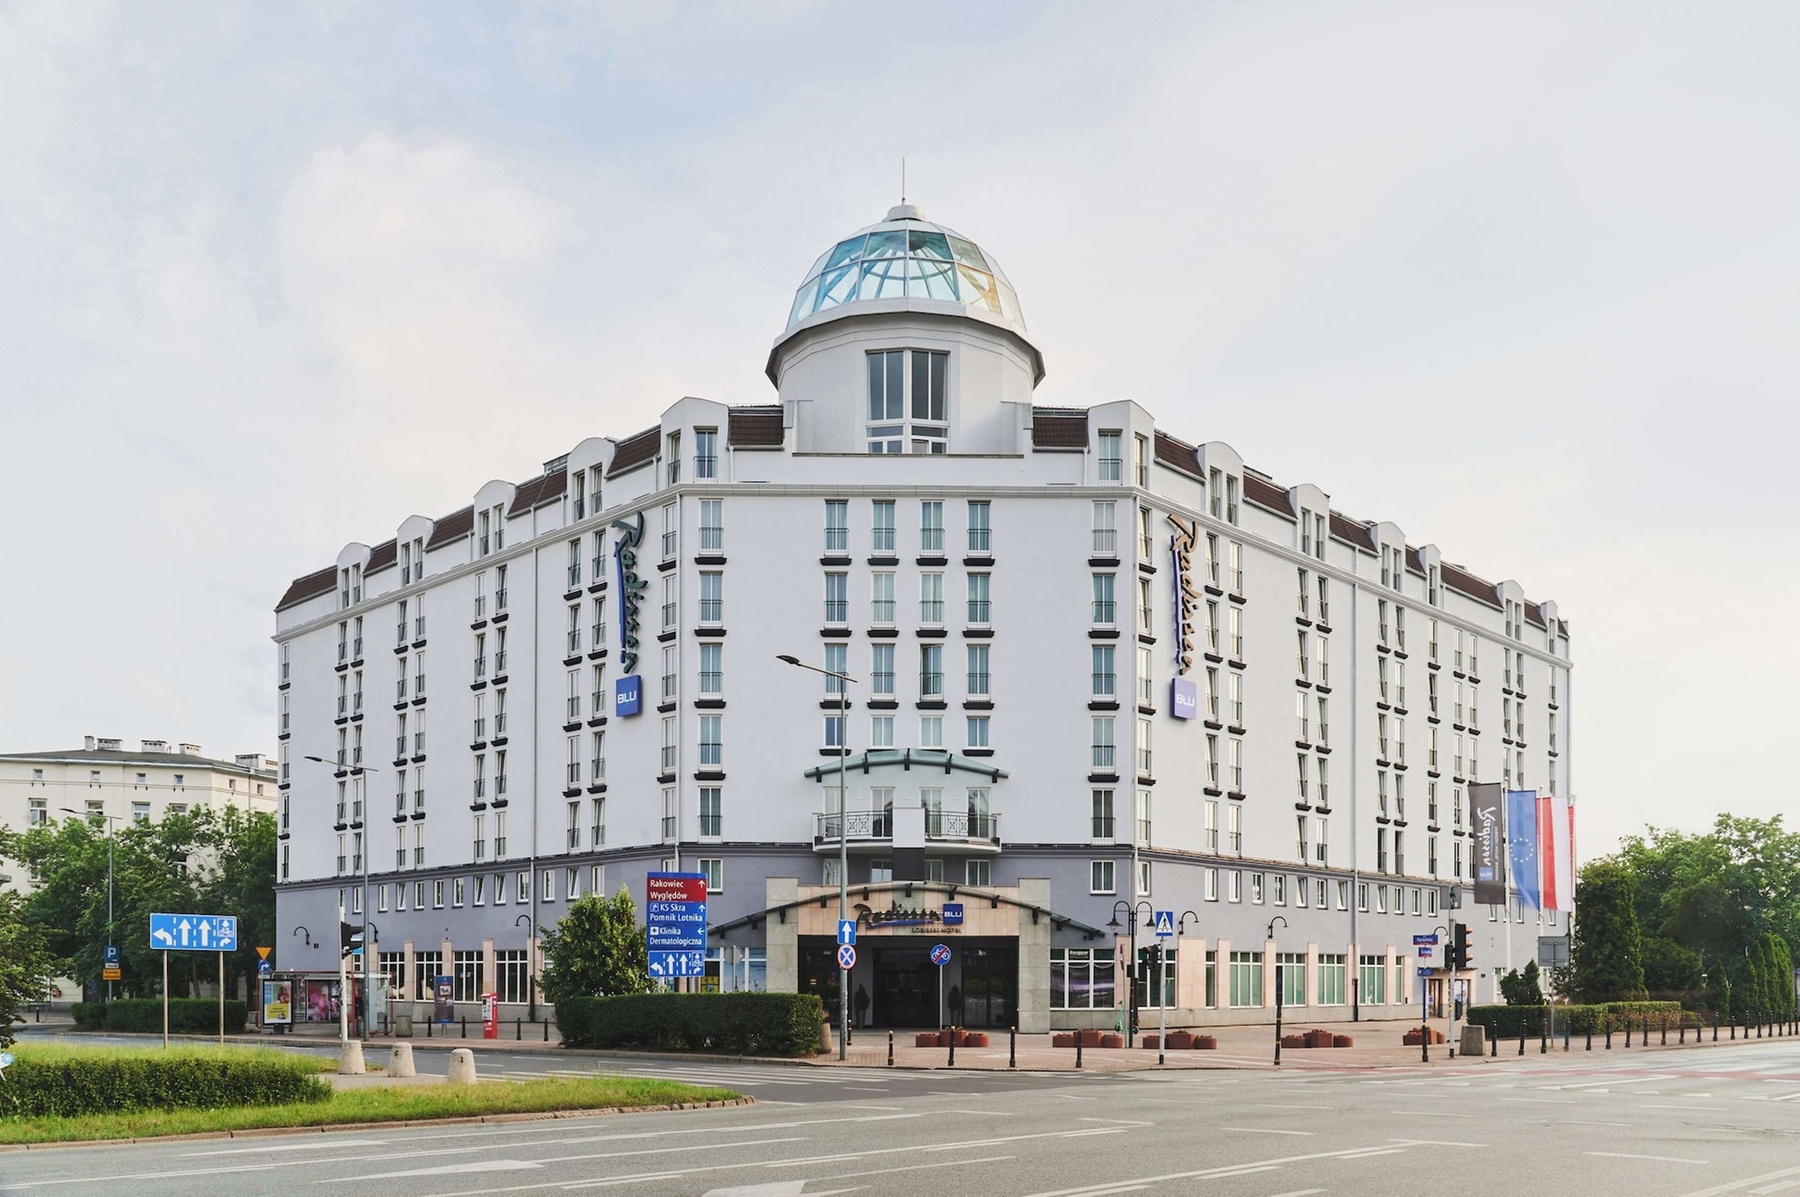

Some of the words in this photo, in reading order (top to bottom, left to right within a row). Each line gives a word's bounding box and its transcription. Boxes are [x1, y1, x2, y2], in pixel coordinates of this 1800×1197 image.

[611, 511, 648, 674] Radisson
[617, 690, 637, 704] BLU
[1176, 693, 1195, 706] BLU
[650, 879, 684, 888] Rakowiec
[650, 891, 687, 901] Wyględów
[660, 926, 681, 935] Klinika
[650, 938, 702, 947] Dermatologiczna
[107, 947, 117, 958] P
